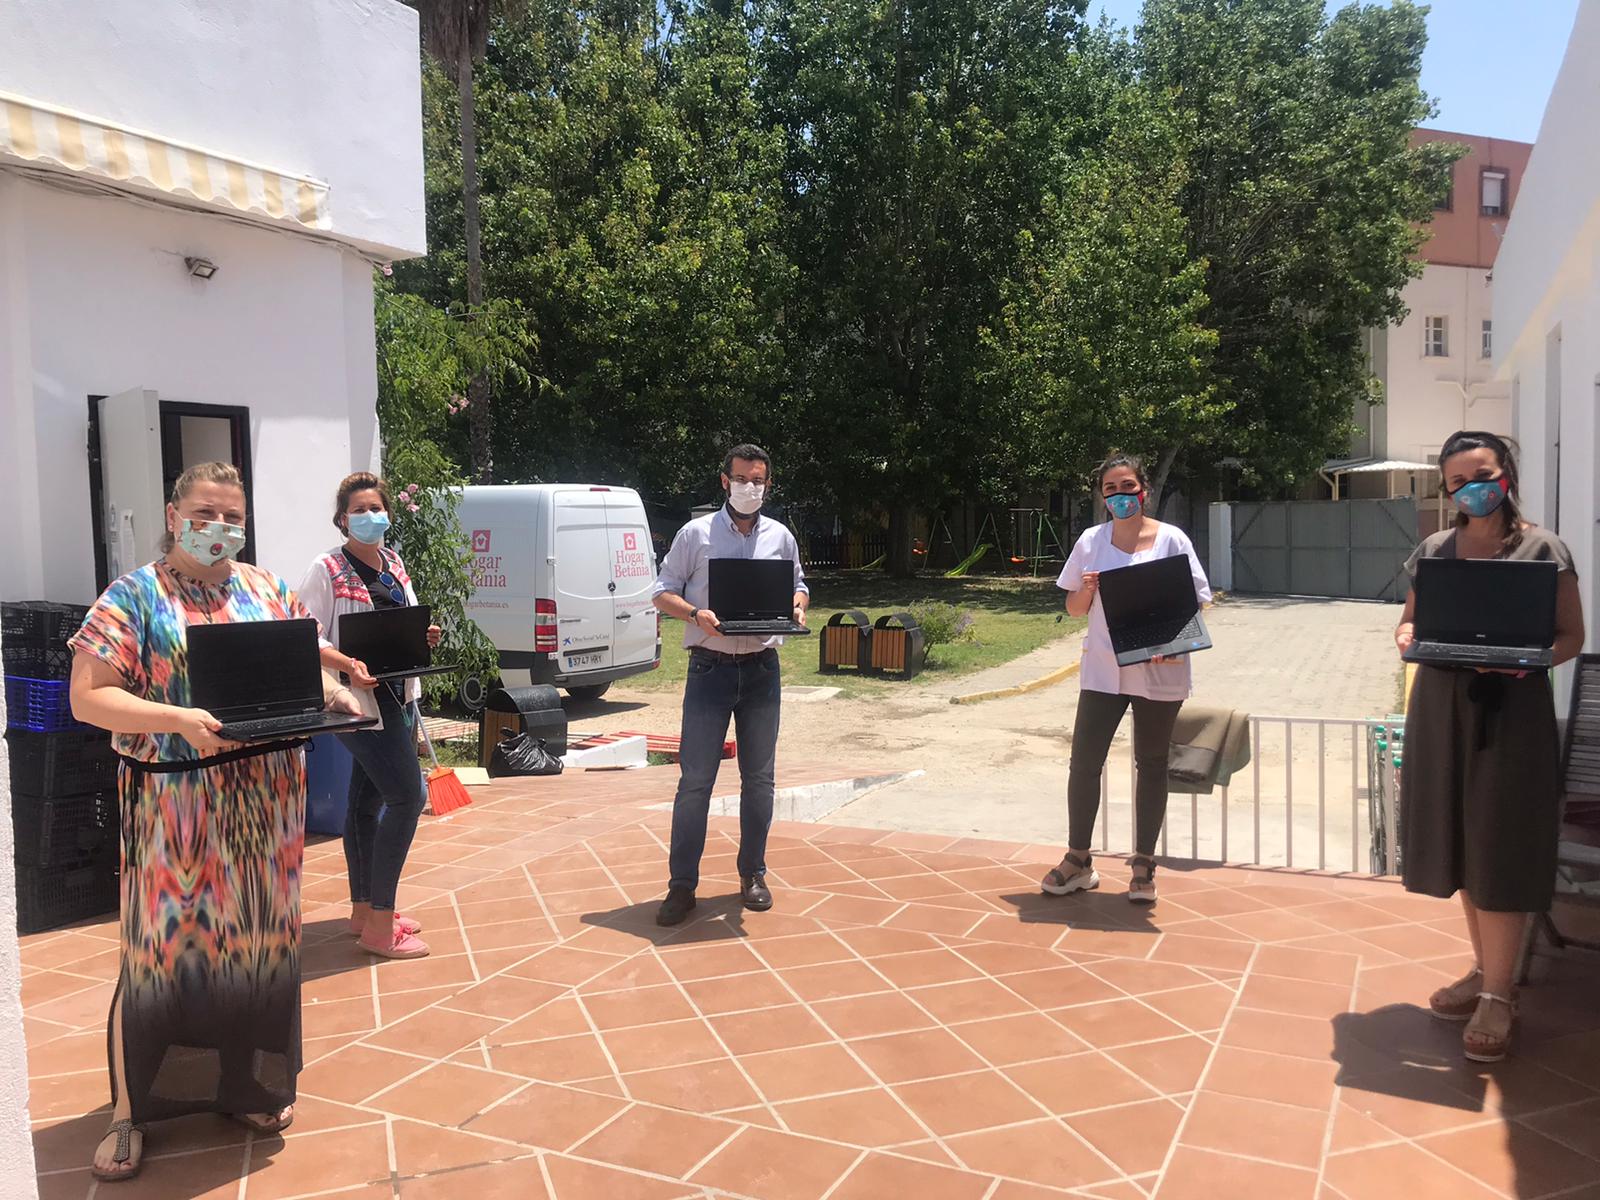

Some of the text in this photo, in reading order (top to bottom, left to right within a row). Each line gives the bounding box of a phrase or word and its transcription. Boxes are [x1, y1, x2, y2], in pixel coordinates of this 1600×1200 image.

[616, 550, 645, 567] Hogar
[614, 564, 650, 578] Betania
[573, 656, 590, 666] 3747
